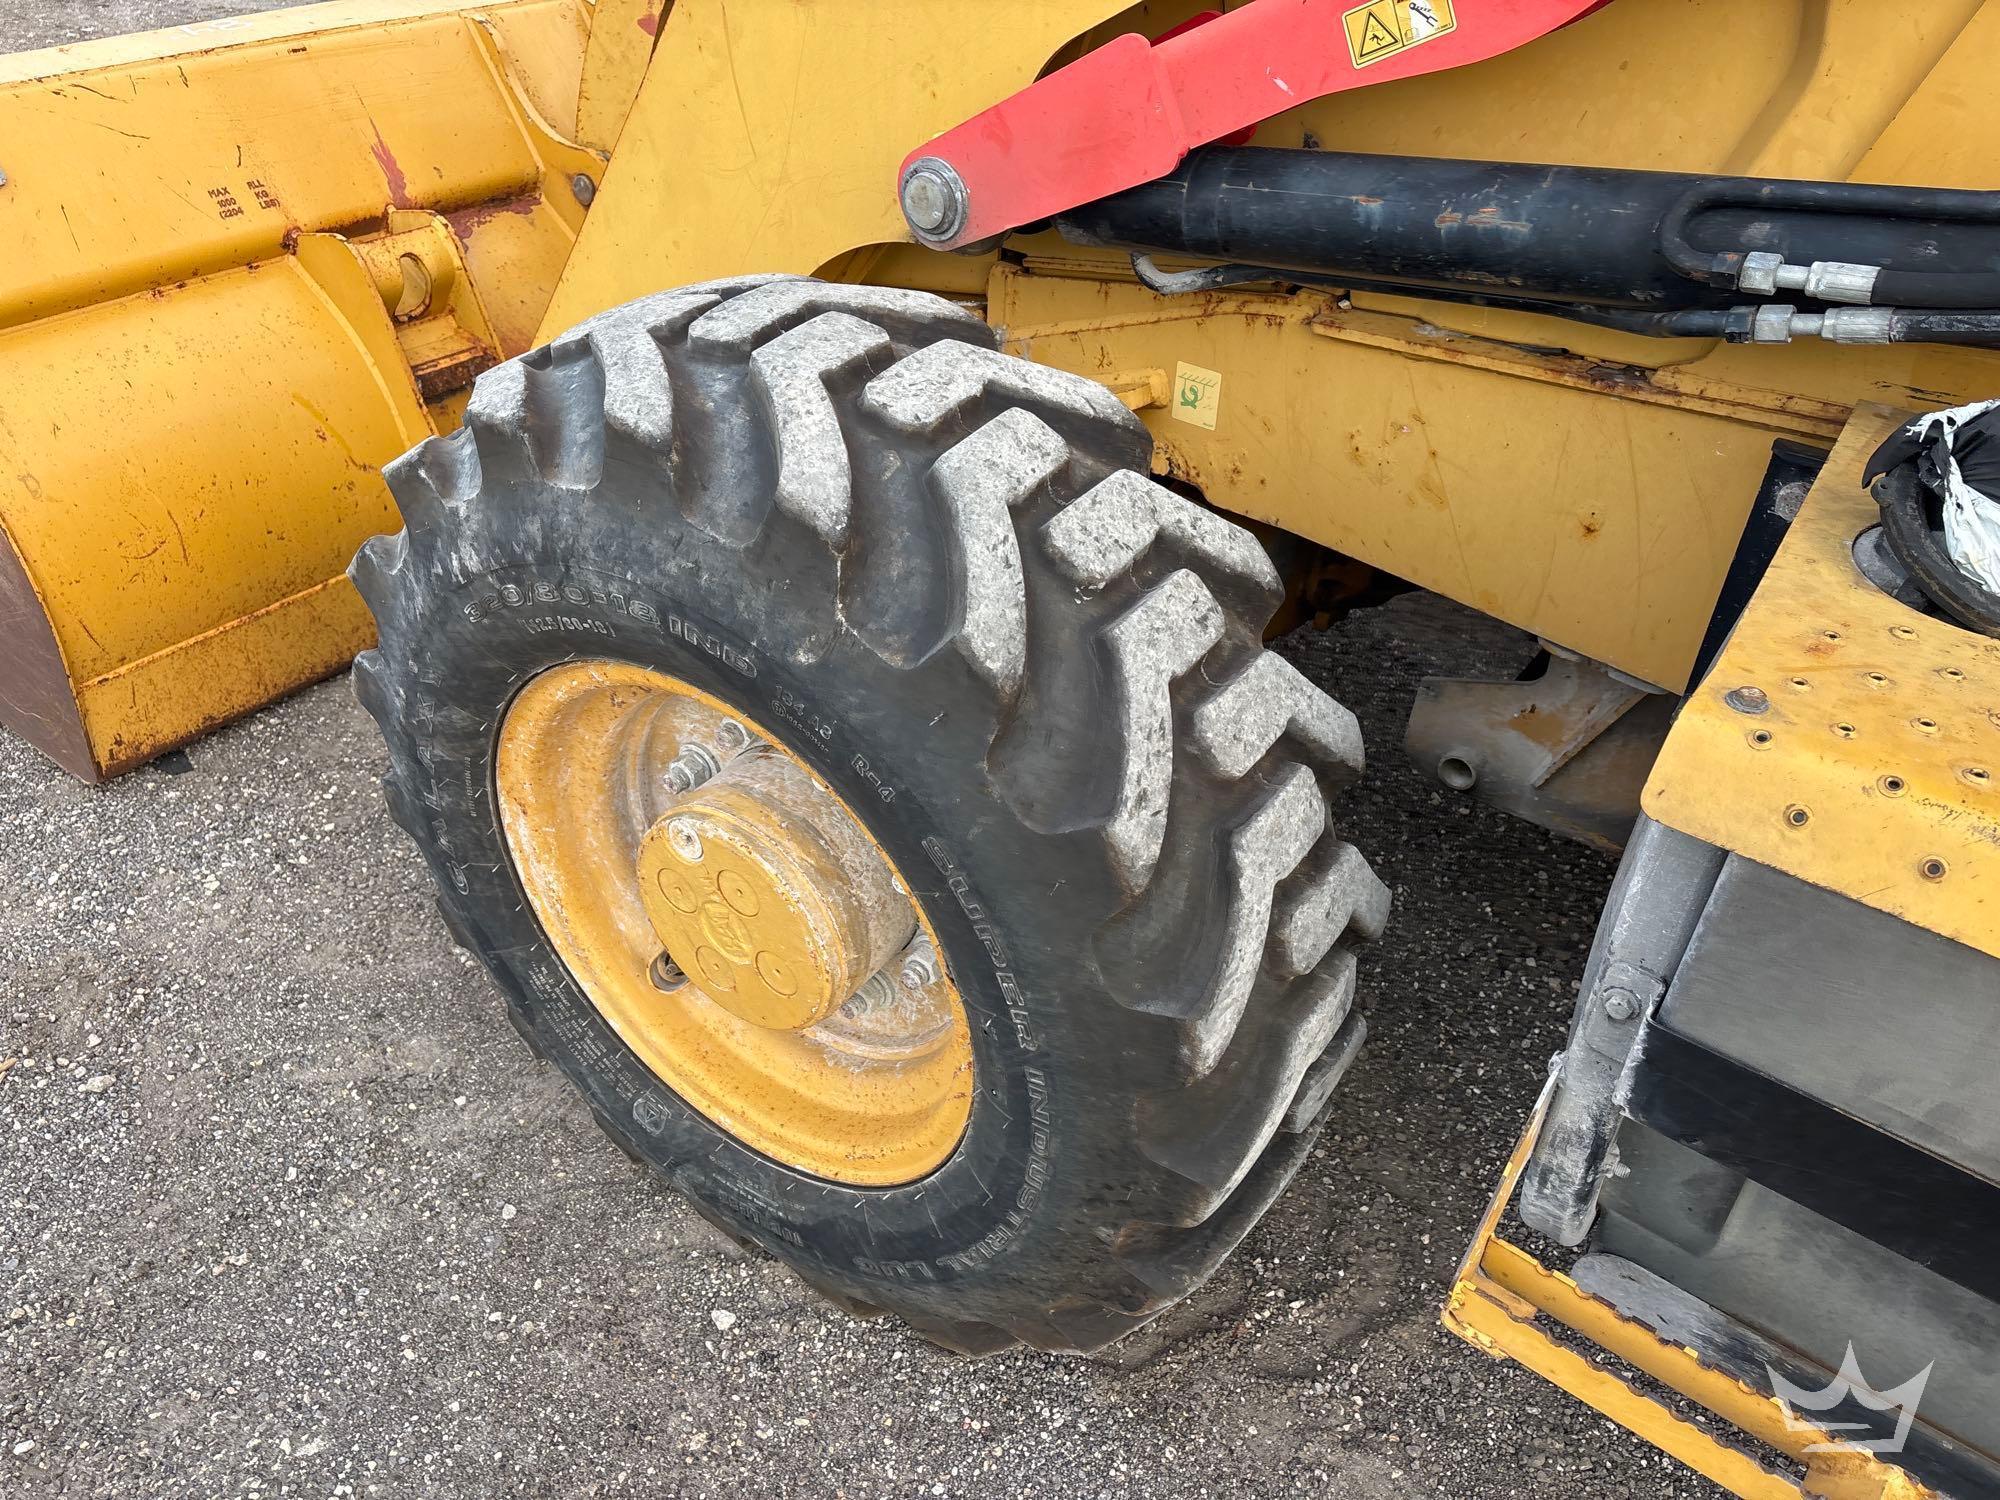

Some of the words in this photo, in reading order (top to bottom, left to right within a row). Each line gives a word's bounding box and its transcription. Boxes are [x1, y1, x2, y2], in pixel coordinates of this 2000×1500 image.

[207, 187, 230, 198] MAX
[217, 198, 237, 208] 1000
[254, 190, 269, 200] KG
[219, 207, 244, 220] (2204
[259, 199, 281, 209] LBS)
[668, 614, 758, 679] IND
[851, 753, 896, 803] R-4
[920, 836, 1038, 1052] SUPER
[936, 1065, 1051, 1271] INDUSTRIAL
